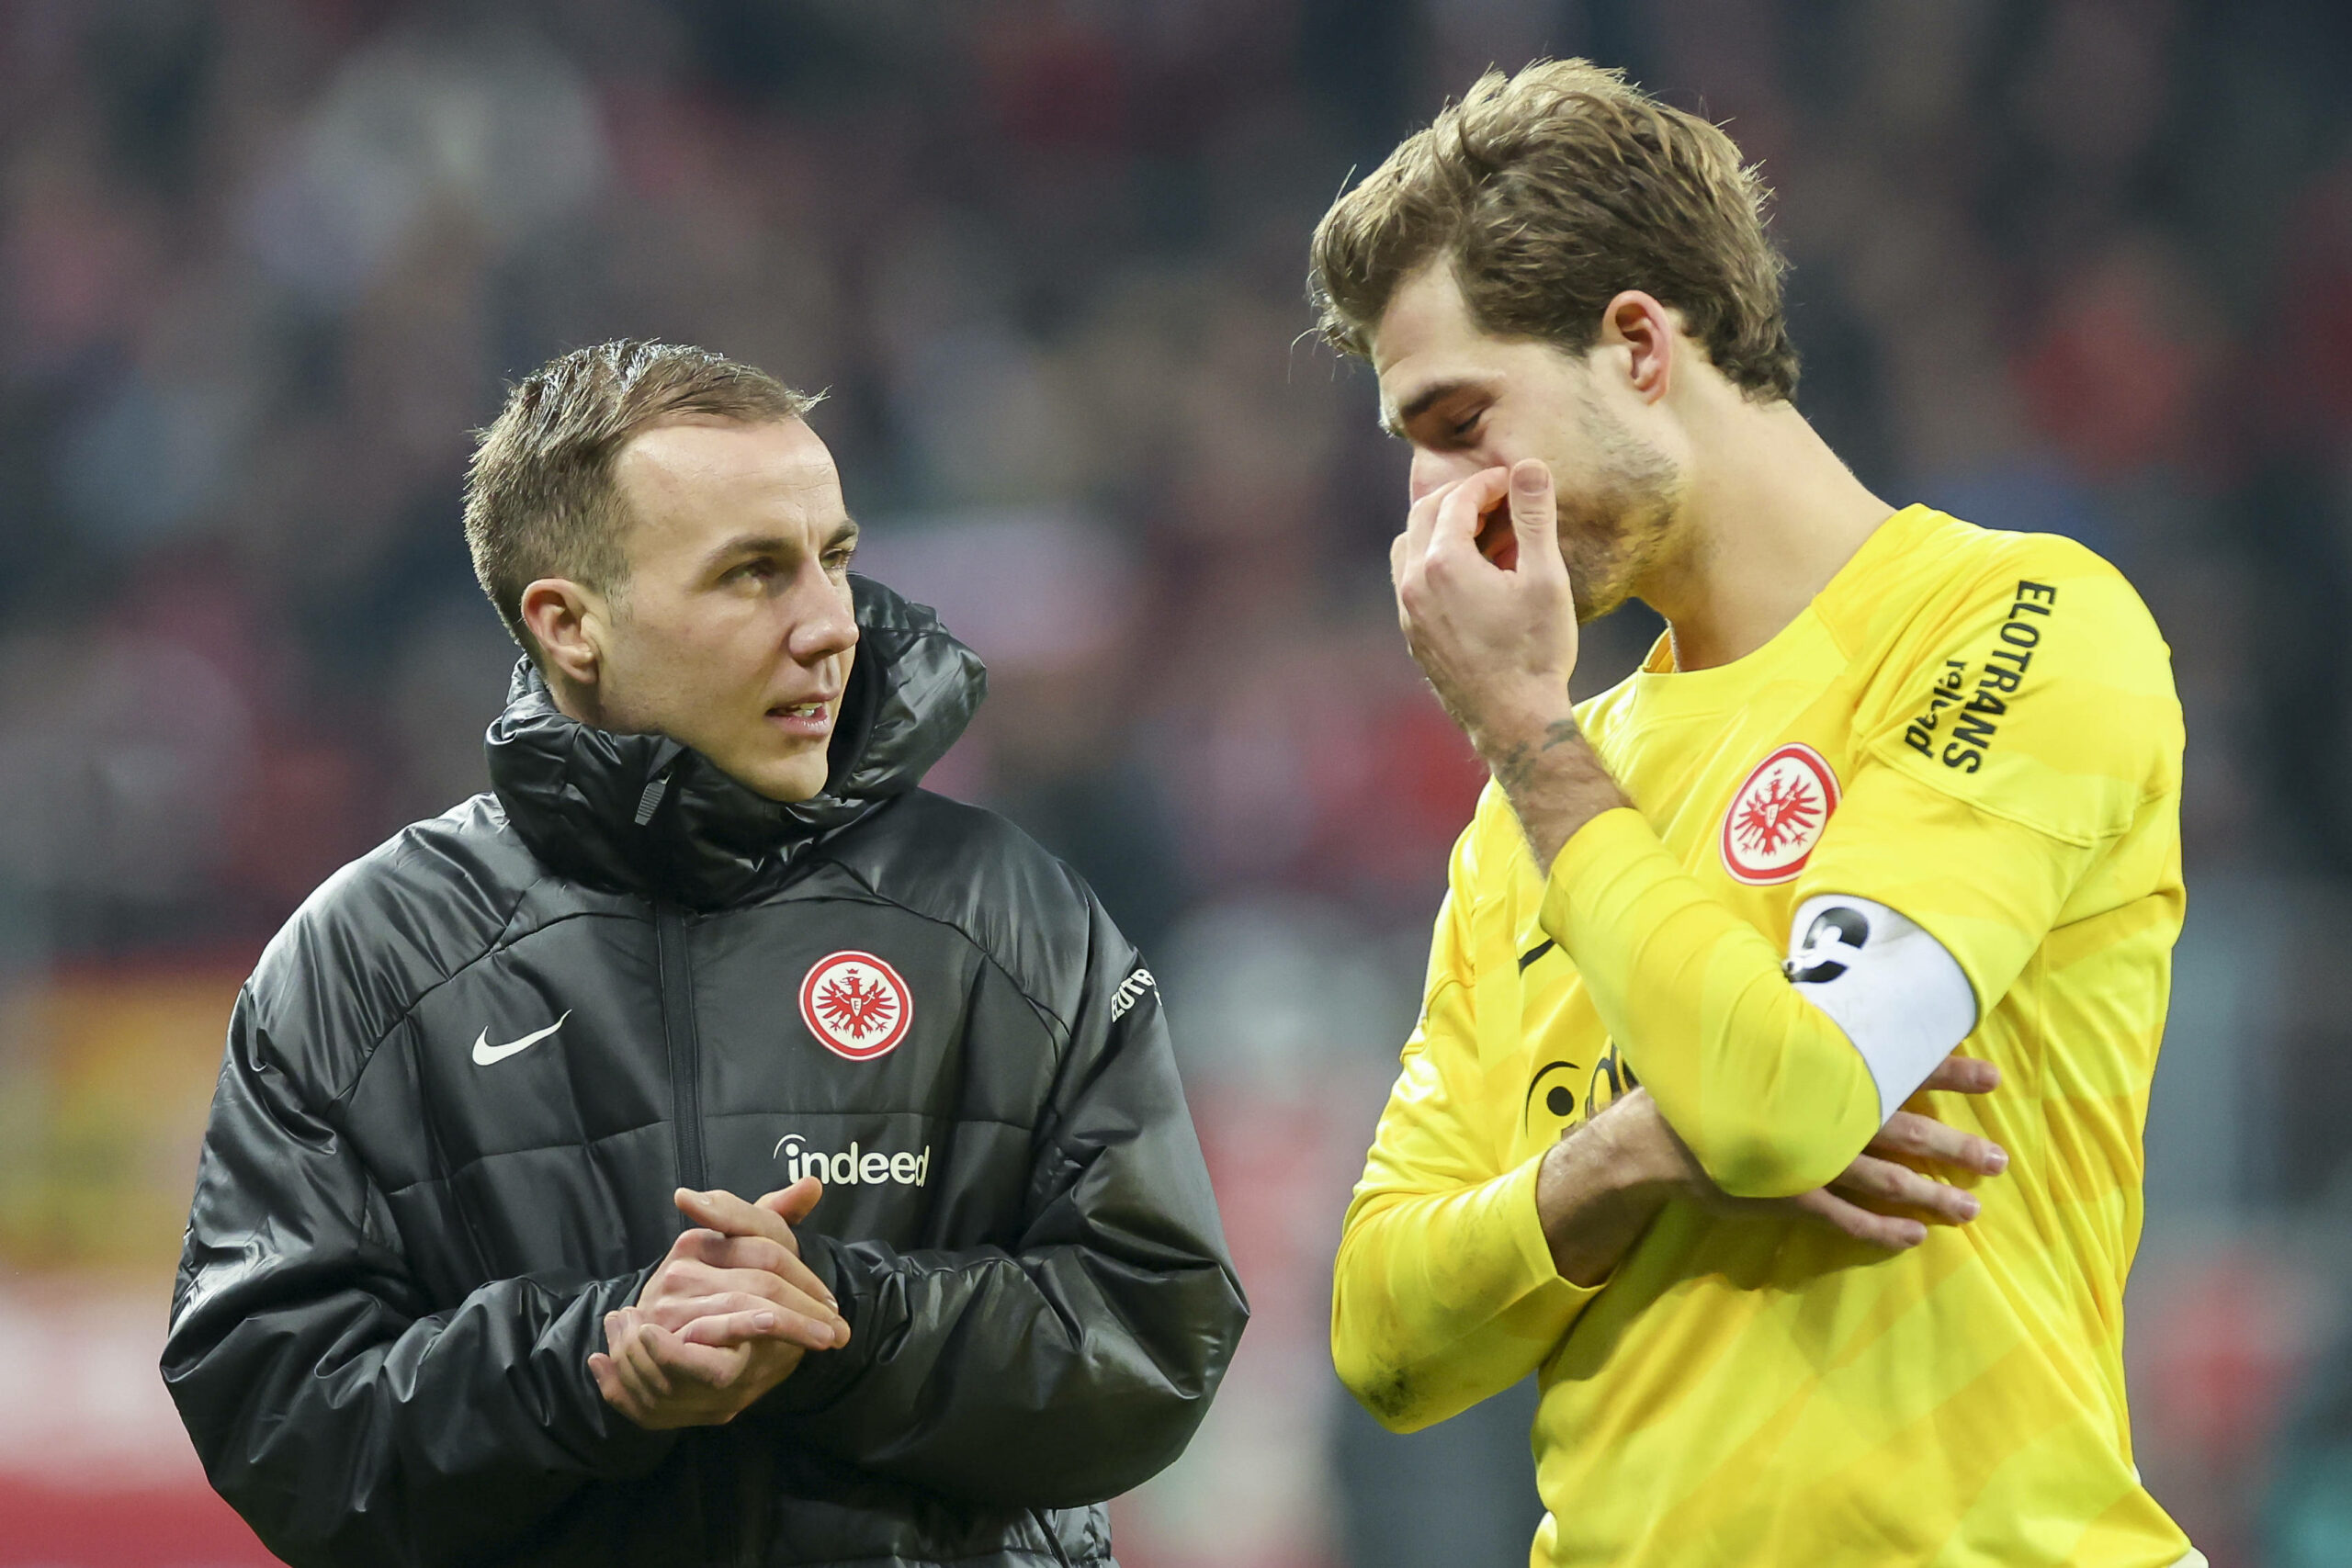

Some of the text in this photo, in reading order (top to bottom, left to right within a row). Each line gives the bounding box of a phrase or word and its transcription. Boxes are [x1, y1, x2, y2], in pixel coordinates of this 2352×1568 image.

[1941, 580, 2057, 774] ELOTRANS
[1111, 968, 1162, 1023] ELOTR
[773, 1134, 931, 1188] indeed
